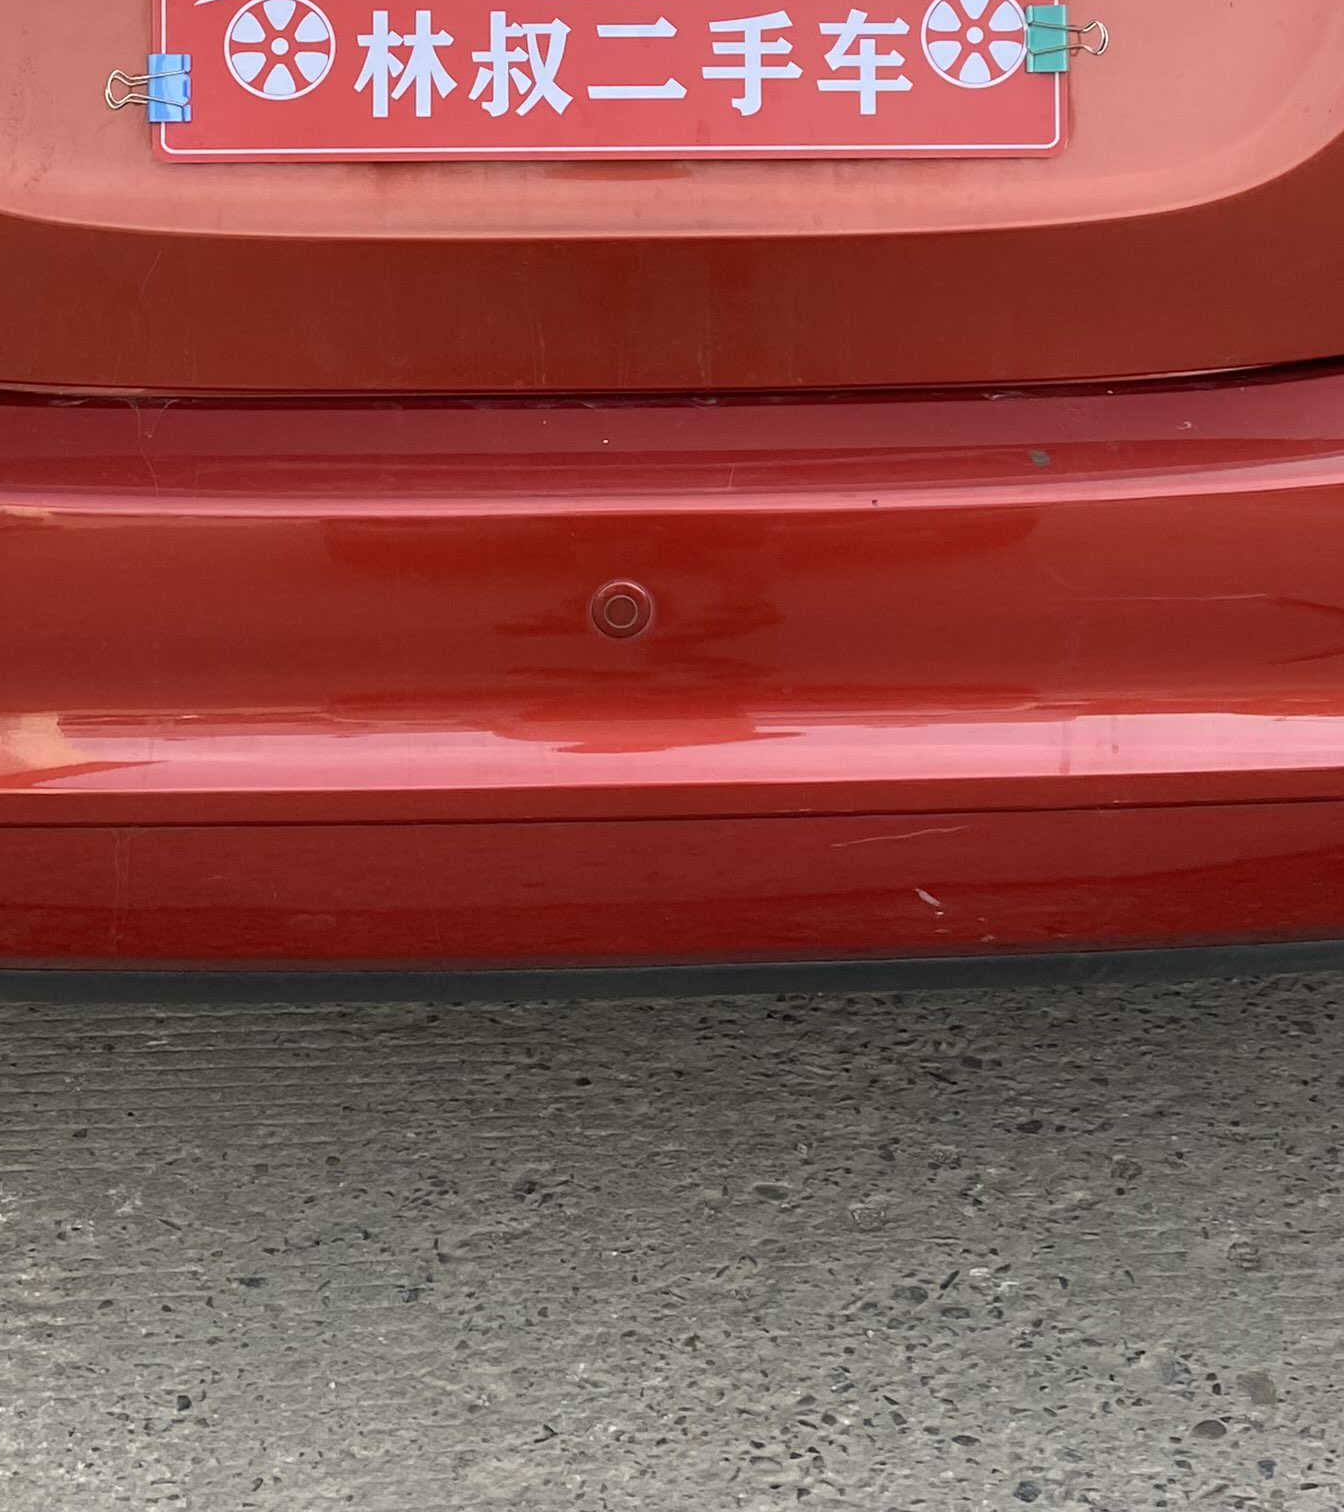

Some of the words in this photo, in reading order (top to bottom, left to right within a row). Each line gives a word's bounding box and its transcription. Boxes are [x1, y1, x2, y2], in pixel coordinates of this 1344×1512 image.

[353, 9, 913, 117] 林叔二手车
